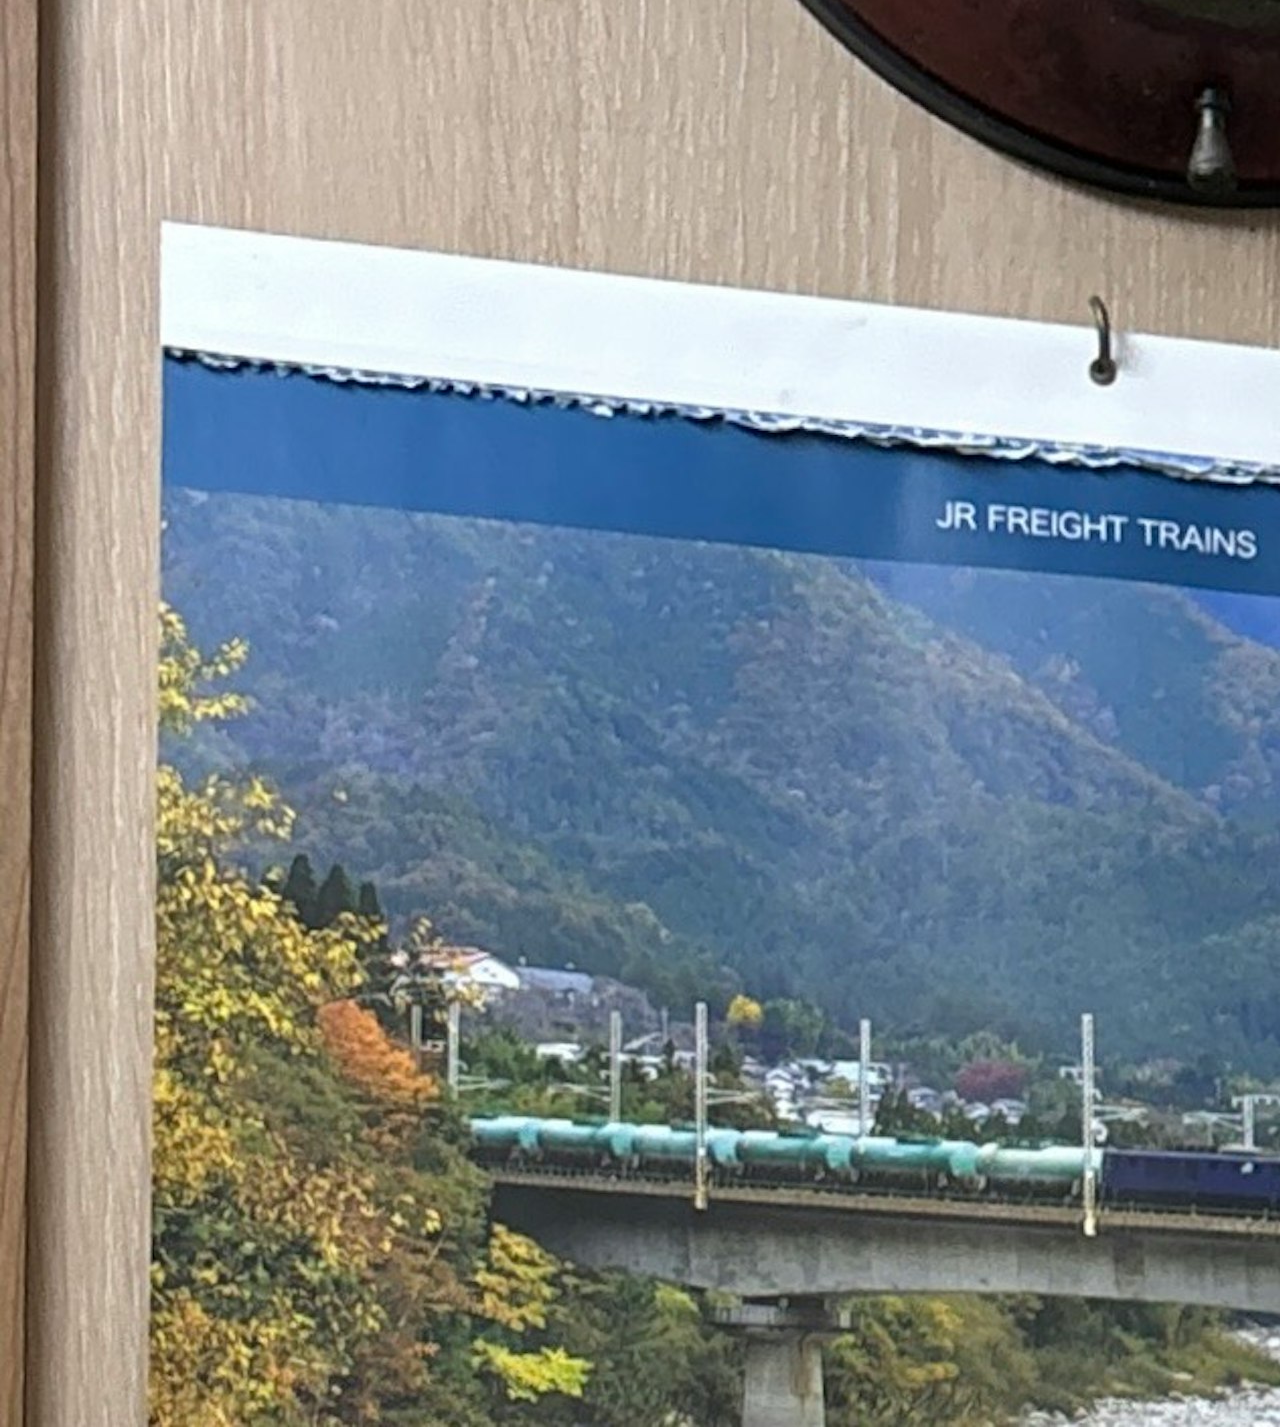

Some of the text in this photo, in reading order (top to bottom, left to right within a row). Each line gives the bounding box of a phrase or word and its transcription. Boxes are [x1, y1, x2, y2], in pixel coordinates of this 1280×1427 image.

[936, 501, 1258, 559] JR FREIGHT TRAINS
